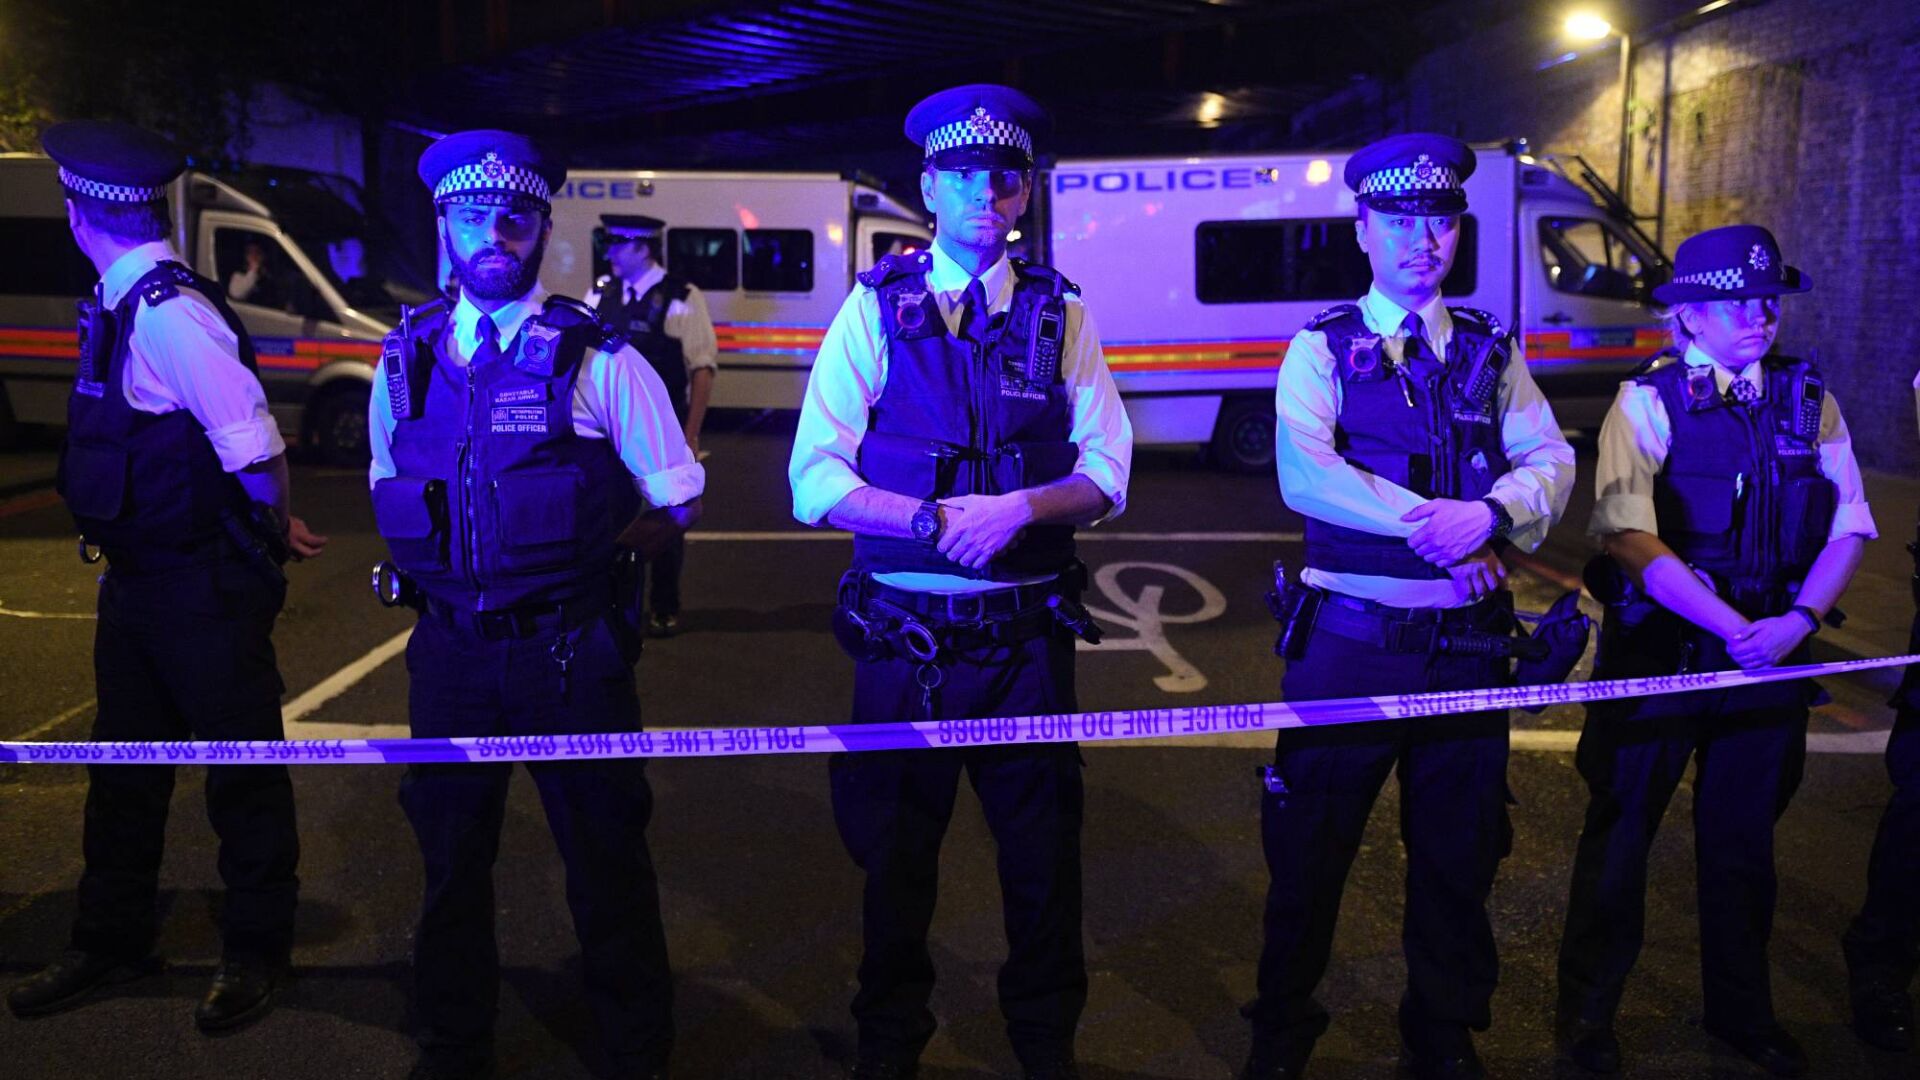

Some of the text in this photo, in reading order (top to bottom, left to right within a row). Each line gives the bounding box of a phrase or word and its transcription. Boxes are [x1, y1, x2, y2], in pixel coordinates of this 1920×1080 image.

[1056, 169, 1252, 194] POLICE
[1001, 389, 1046, 401] POLICE OFFICER
[491, 424, 547, 433] POLICE OFFICER
[938, 703, 1264, 745] POLICE LINE DO NOT CROSS
[475, 727, 806, 758] POLICE LINE DO NOT CROSS
